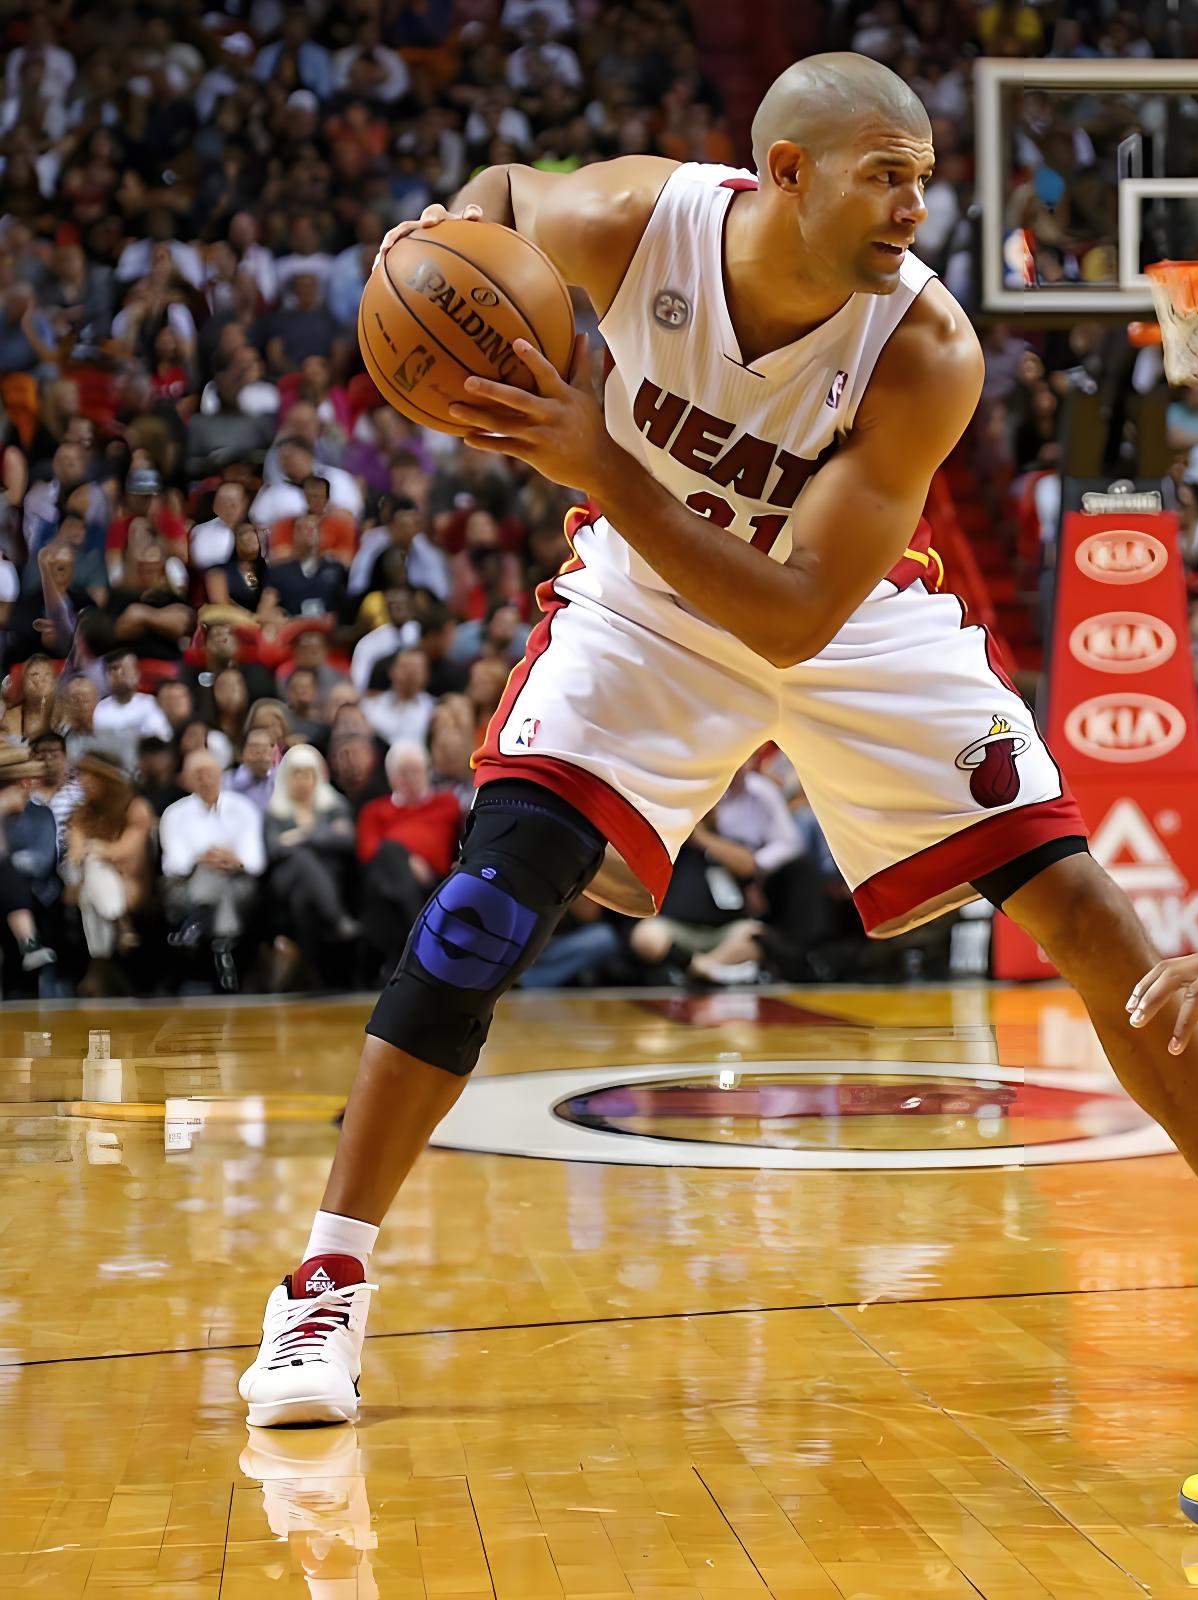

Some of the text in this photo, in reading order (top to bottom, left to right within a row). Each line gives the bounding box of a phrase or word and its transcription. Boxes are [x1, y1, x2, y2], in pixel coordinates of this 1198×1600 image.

[633, 377, 818, 508] HEAT
[1087, 624, 1159, 660] KIA
[1085, 706, 1168, 747] KIA
